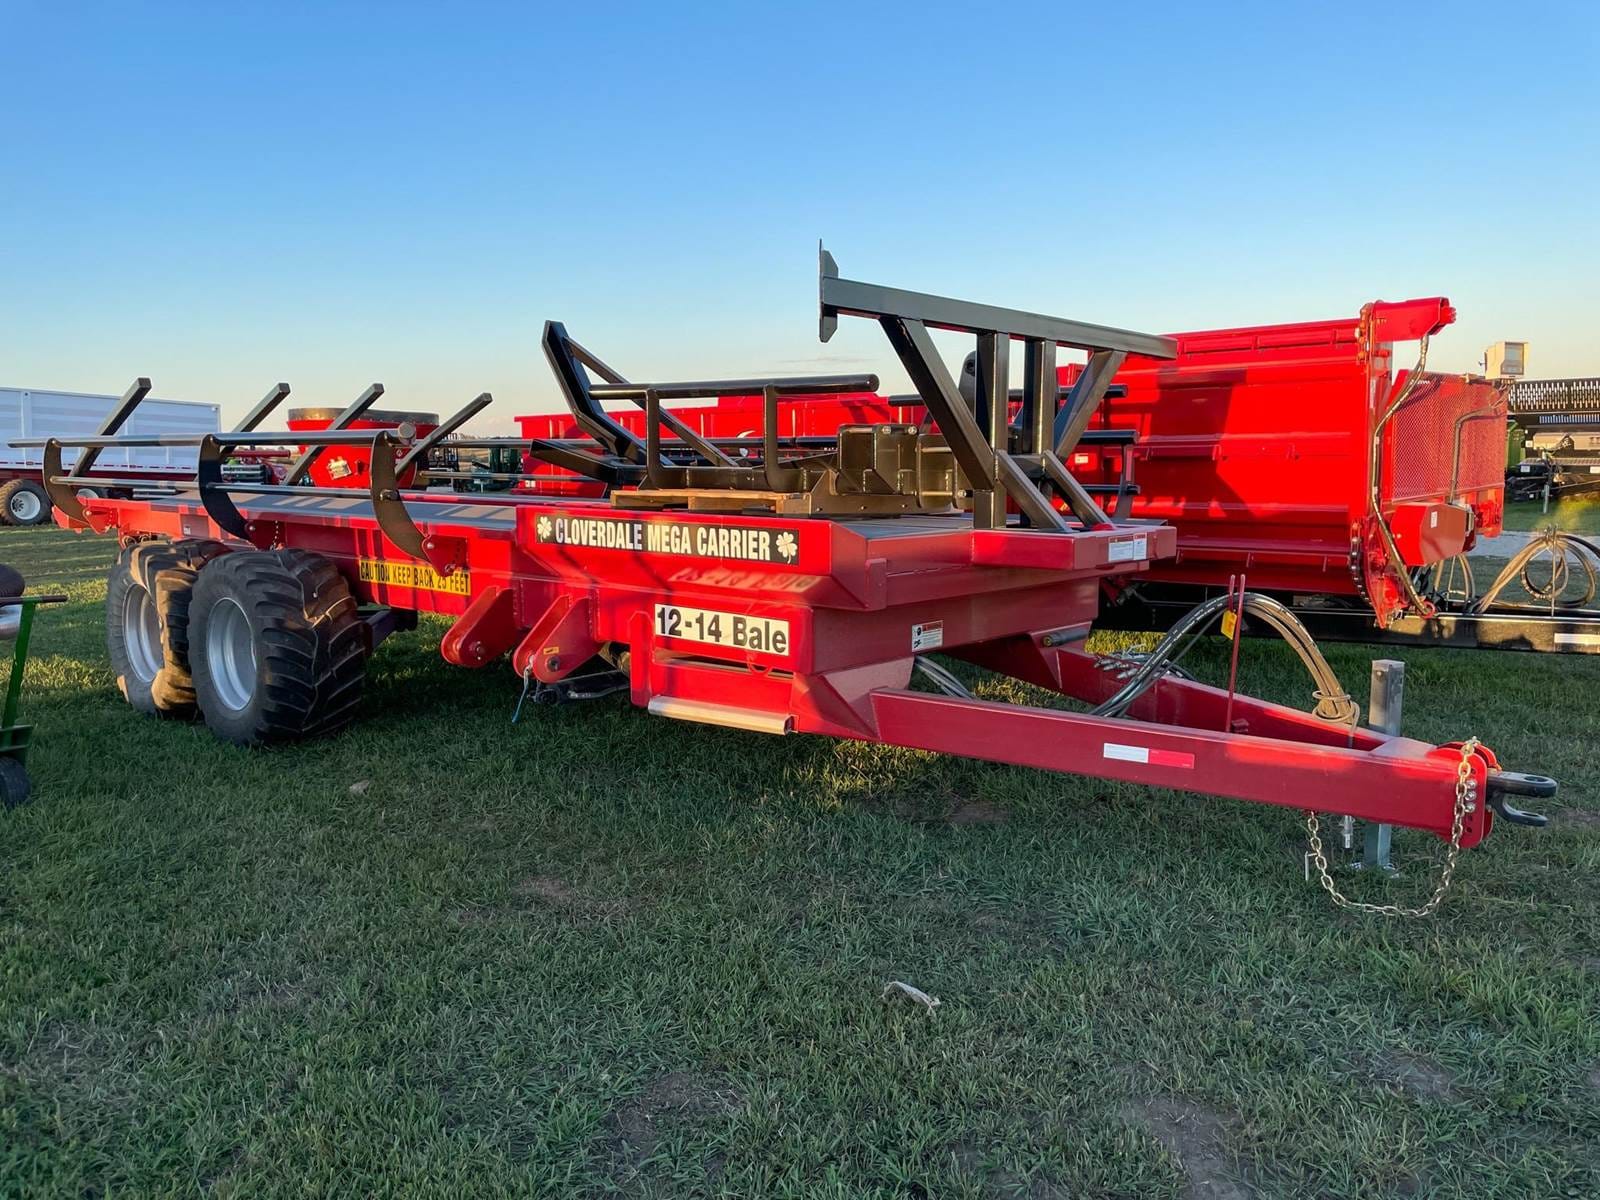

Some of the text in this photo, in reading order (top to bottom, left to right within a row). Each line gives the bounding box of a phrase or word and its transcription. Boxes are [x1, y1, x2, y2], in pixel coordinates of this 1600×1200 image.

[555, 518, 771, 561] CLOVERDALE MEGA CARRIER
[360, 562, 390, 582] CAUTION
[393, 566, 411, 585] KEEP
[413, 567, 434, 588] BACK
[450, 572, 469, 593] FEET
[657, 607, 787, 653] 12-14 Bale
